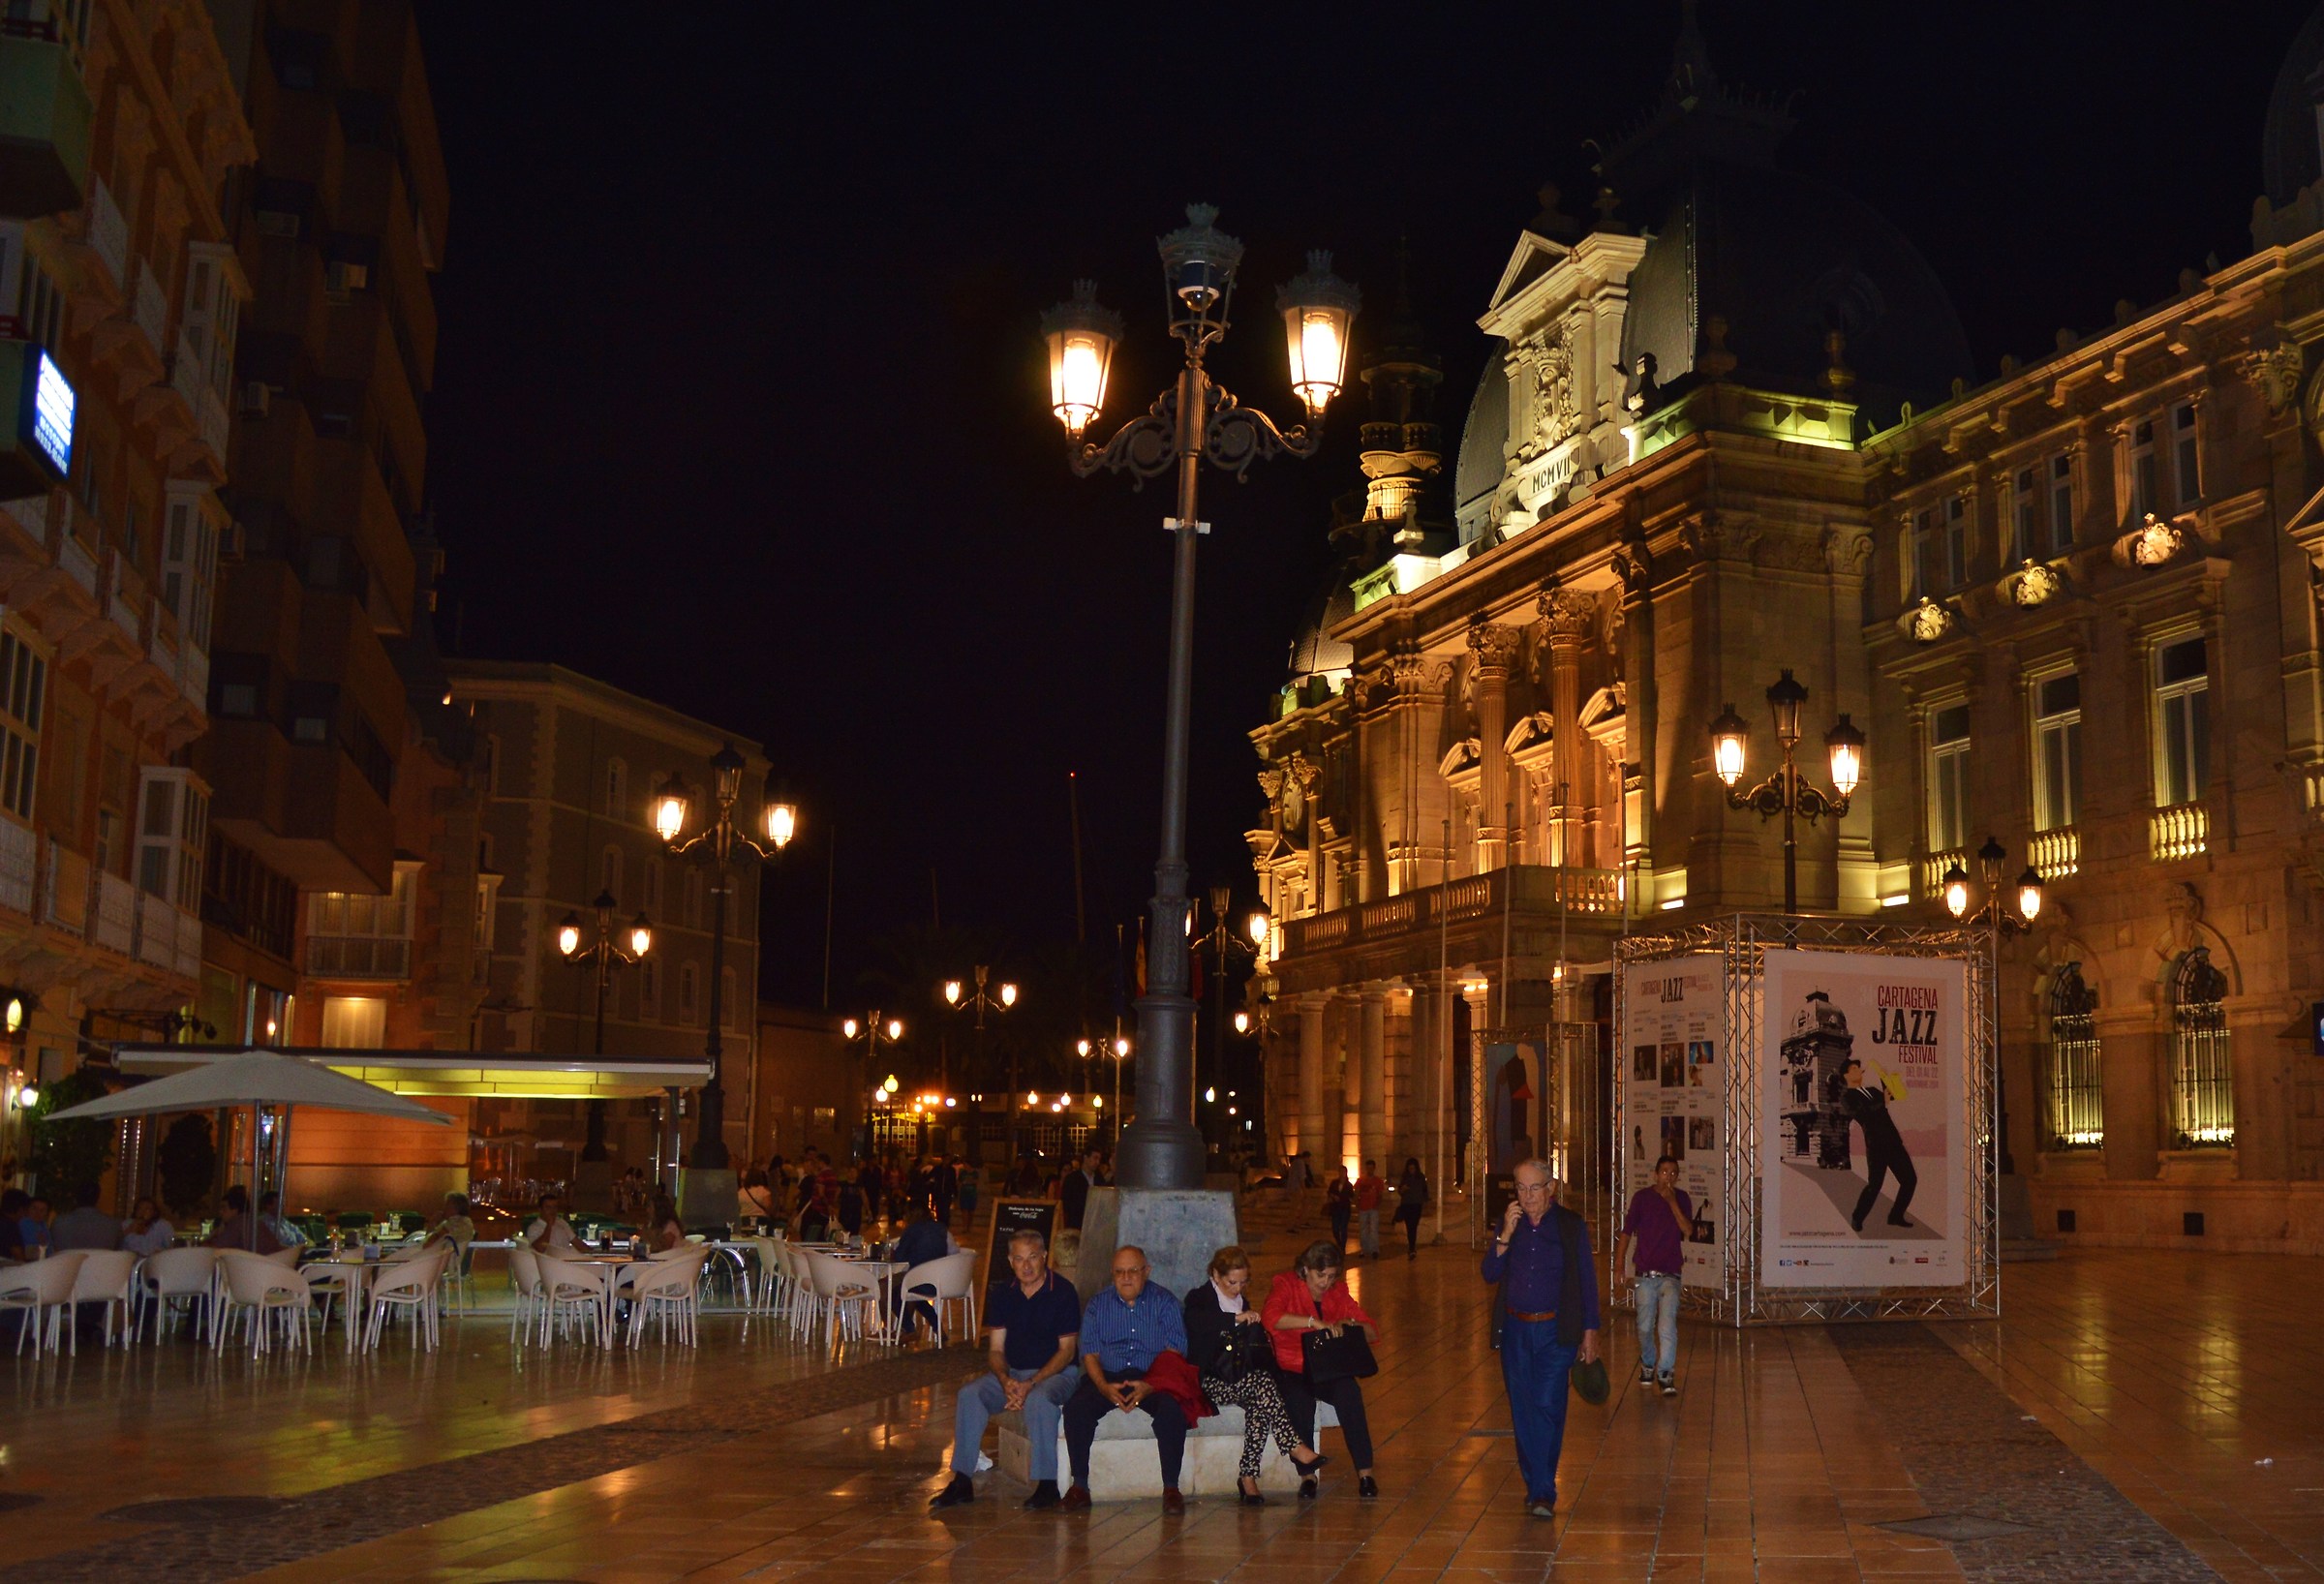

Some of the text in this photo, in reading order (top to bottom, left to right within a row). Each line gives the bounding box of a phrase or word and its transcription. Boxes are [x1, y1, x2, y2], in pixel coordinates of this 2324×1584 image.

[1533, 456, 1570, 493] MCMVII
[1661, 977, 1684, 1003] JAZZ
[1878, 986, 1938, 1010] CARTAGENA
[1872, 1008, 1938, 1046] JAZZ
[1898, 1046, 1938, 1064] FESTIVAL
